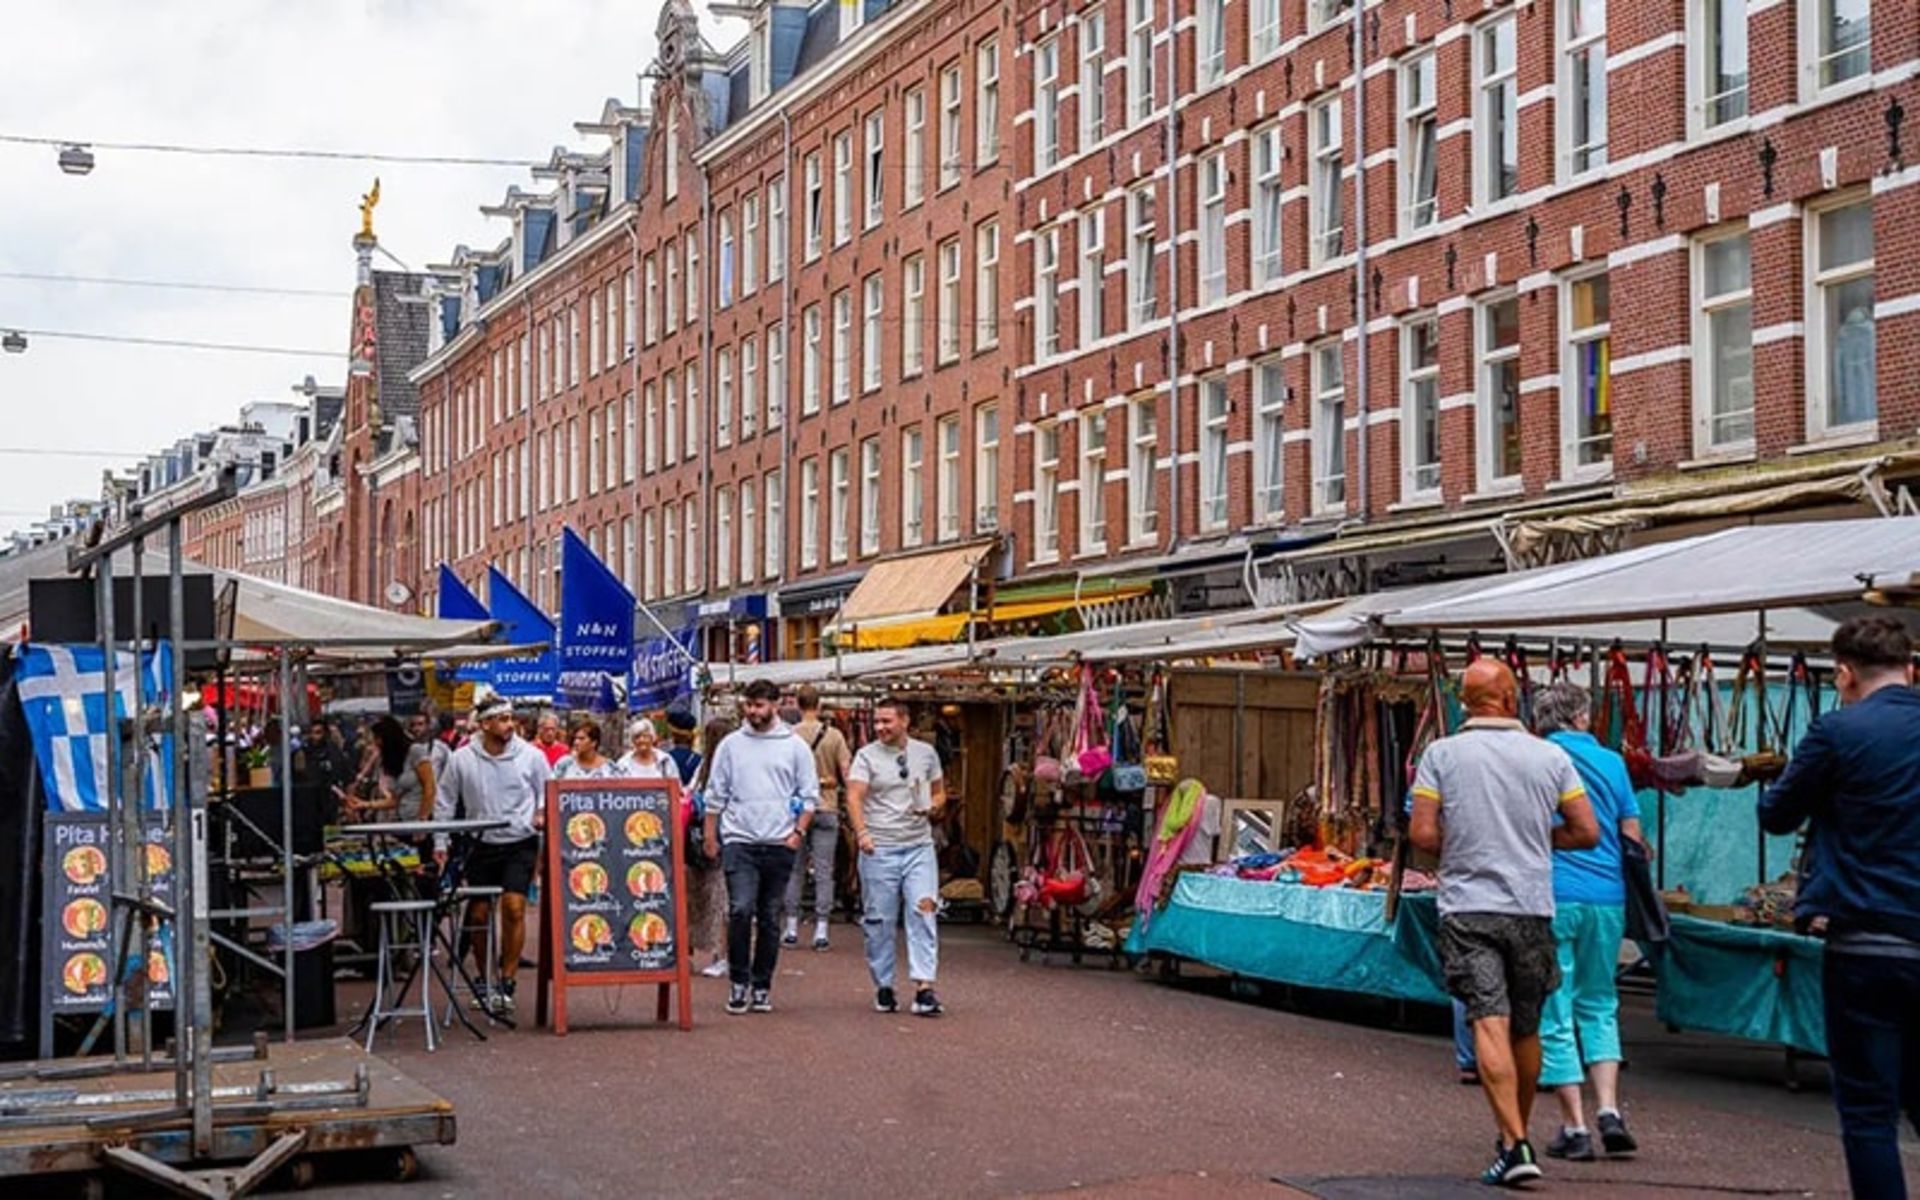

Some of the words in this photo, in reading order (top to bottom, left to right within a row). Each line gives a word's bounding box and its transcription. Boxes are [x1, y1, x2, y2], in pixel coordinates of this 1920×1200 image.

[576, 623, 617, 638] N&N
[565, 644, 627, 657] STOFFEN
[496, 671, 551, 683] STOFFEN
[559, 792, 594, 811] Pita
[599, 792, 656, 810] Home
[55, 825, 94, 845] Pita
[194, 813, 203, 841] 1
